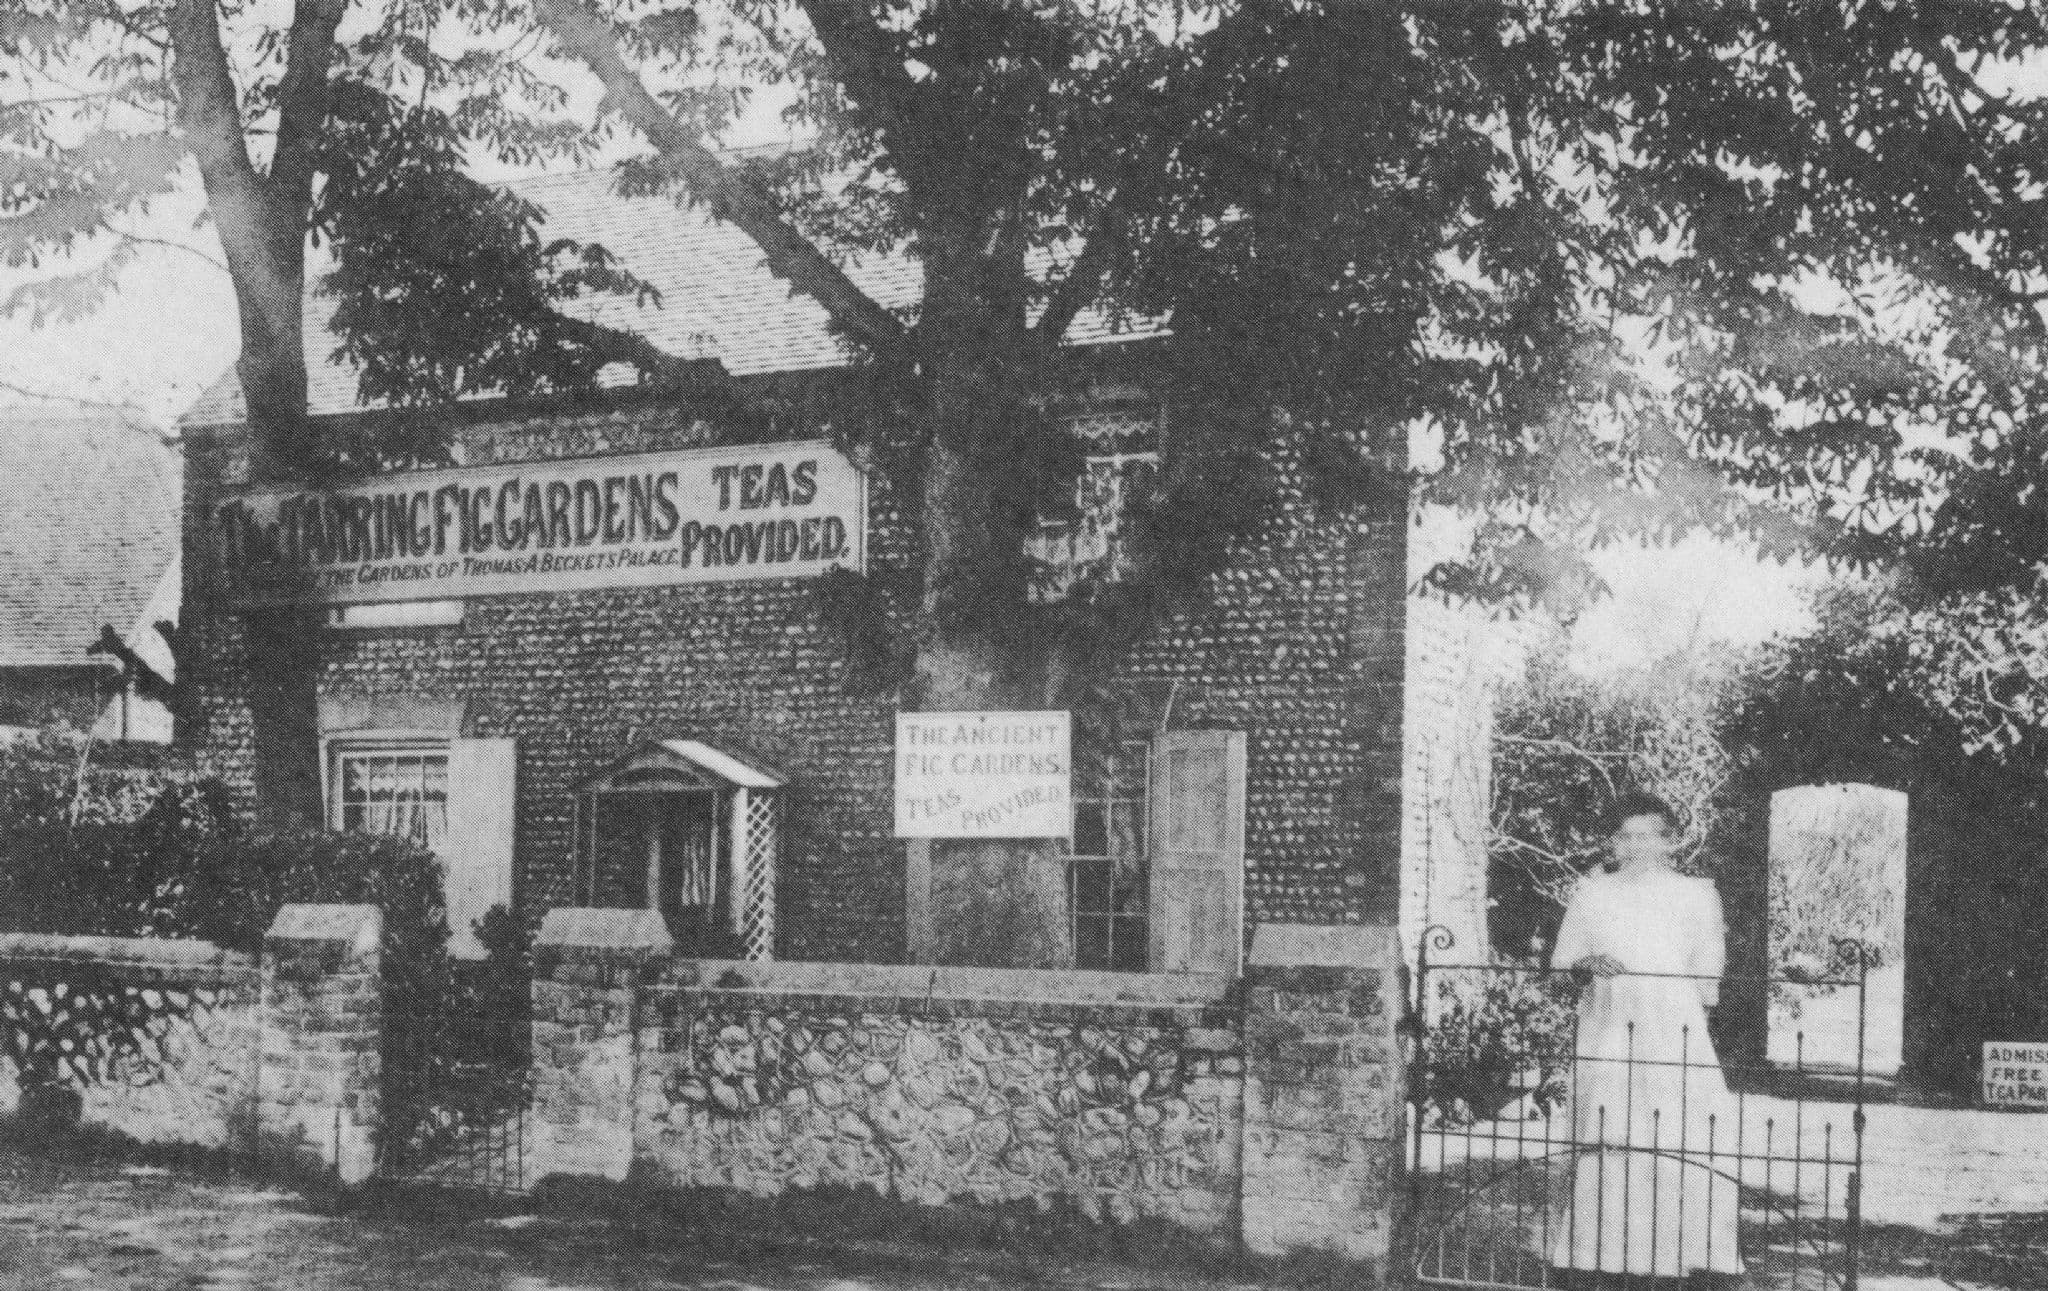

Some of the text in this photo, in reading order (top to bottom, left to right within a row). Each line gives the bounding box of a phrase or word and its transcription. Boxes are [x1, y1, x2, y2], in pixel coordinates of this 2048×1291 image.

[711, 459, 818, 511] TEAS
[433, 483, 494, 556] FIG
[495, 471, 681, 551] GARDENS
[435, 560, 460, 580] OF
[905, 724, 1059, 745] THE ANCIENT
[906, 789, 961, 820] TEAS
[1989, 1047, 2048, 1063] ADMIS
[1991, 1066, 2042, 1081] FREE
